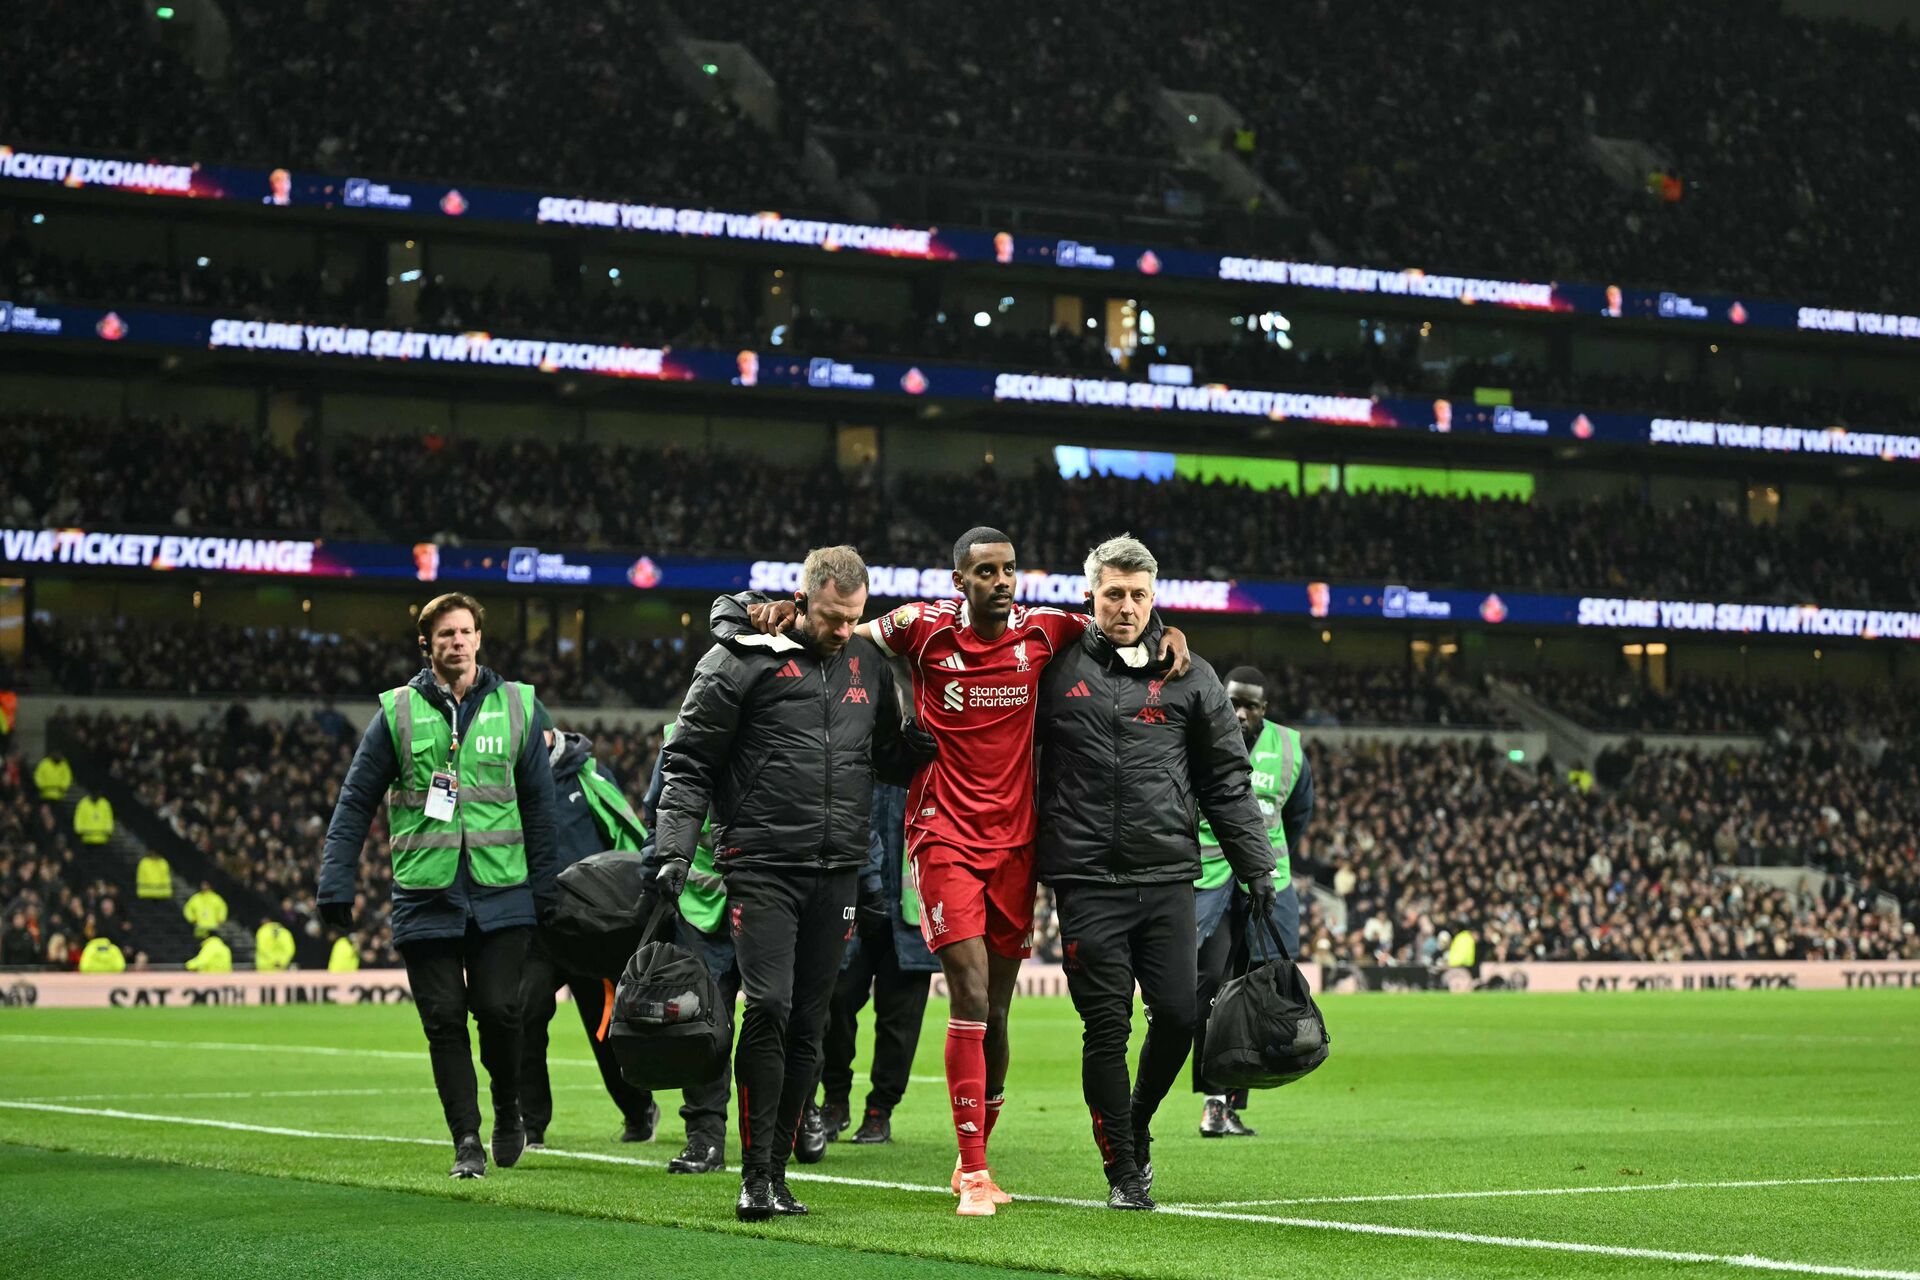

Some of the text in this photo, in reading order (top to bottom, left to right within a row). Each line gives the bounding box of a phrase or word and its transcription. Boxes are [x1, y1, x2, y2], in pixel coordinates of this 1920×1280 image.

[0, 153, 192, 191] ICKET EXCHANGE
[538, 197, 619, 226] SECURE
[620, 204, 675, 231] YOUR
[675, 209, 725, 235] SEAT
[760, 215, 829, 245] TICKET
[827, 223, 930, 253] EXCHANGE
[1219, 257, 1288, 283] SECURE
[1288, 263, 1336, 287] YOUR
[210, 319, 663, 374] SECURE YOUR SEAT VIA TICKET EXCHANGE
[995, 374, 1074, 402] SECURE
[1074, 379, 1128, 405] YOUR
[1651, 419, 1715, 444] SECURE
[1715, 424, 1762, 448] YOUR
[4, 529, 314, 572] VIA TICKET EXCHANGE
[750, 561, 804, 592] SEC
[867, 566, 919, 597] OUR
[1022, 572, 1089, 603] TICKE
[1154, 579, 1230, 610] HANGE
[1578, 598, 1658, 627] SECURE
[1659, 602, 1715, 630] YOUR
[1716, 604, 1764, 631] SEAT
[1765, 606, 1801, 633] VIA
[1800, 608, 1867, 636] TICKET
[841, 687, 870, 704] AXA
[969, 684, 1028, 697] standard
[969, 694, 1029, 707] chartered
[1132, 707, 1167, 723] AXA
[475, 736, 503, 754] 011
[1251, 771, 1275, 789] 021
[109, 987, 171, 1006] SAT
[259, 985, 338, 1004] JUNE
[1578, 976, 1620, 991] SAT
[954, 1096, 978, 1107] LFC
